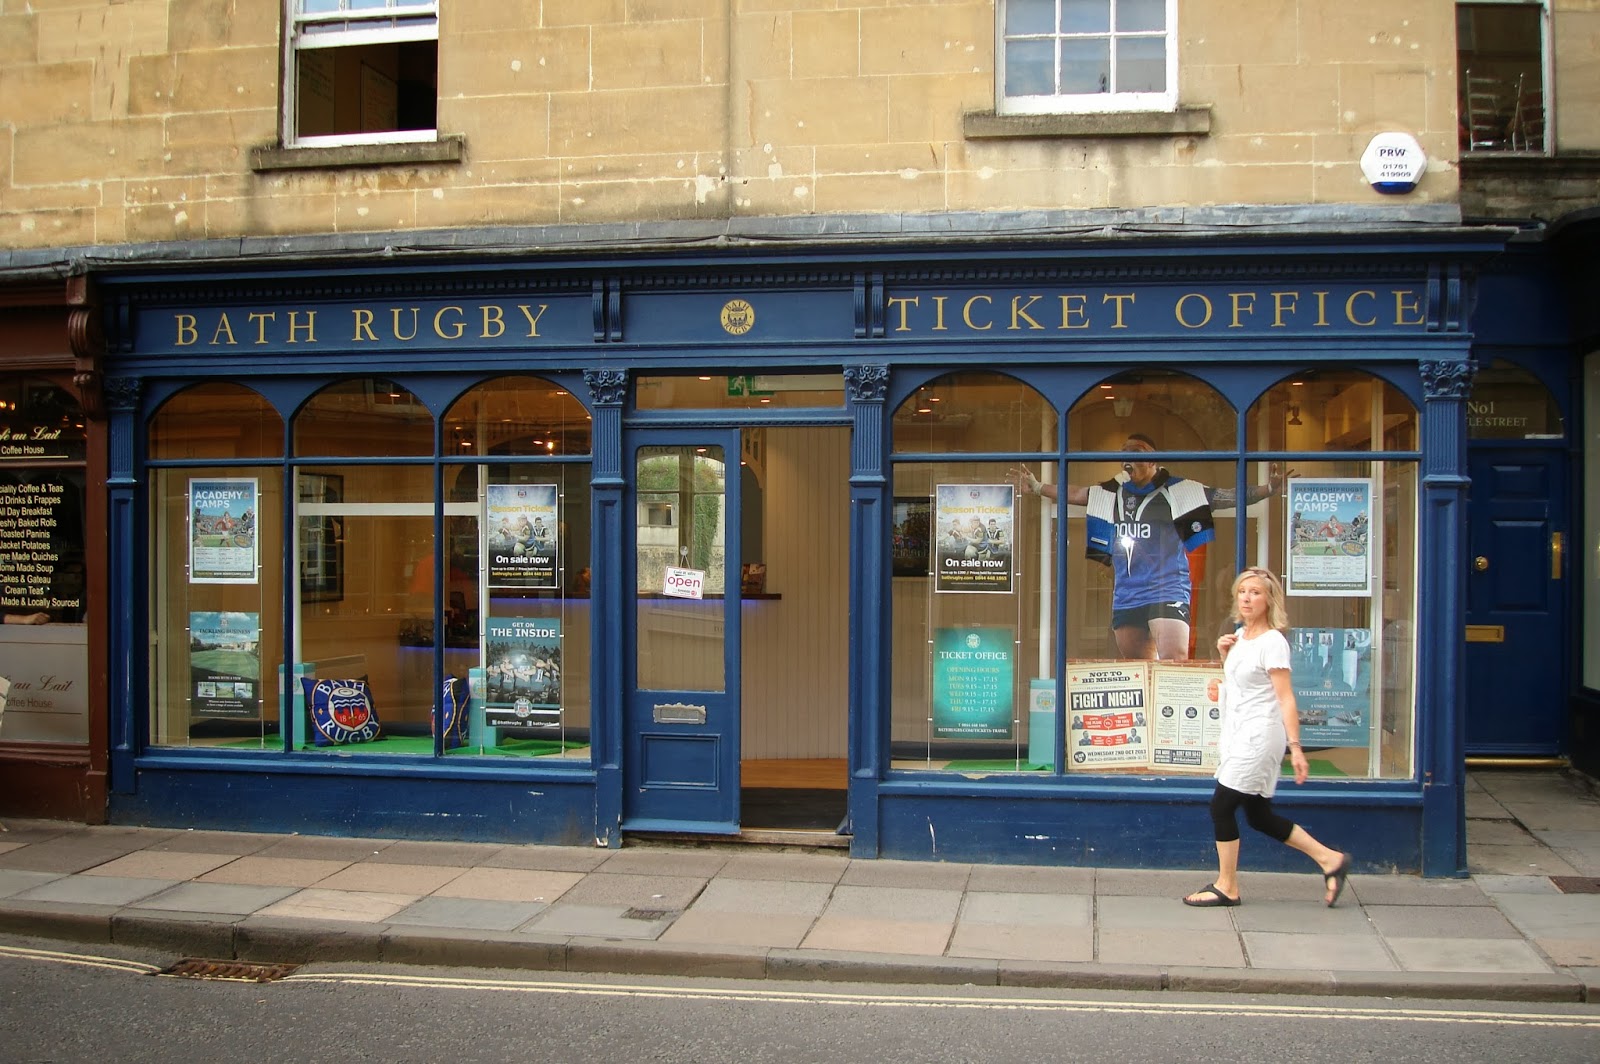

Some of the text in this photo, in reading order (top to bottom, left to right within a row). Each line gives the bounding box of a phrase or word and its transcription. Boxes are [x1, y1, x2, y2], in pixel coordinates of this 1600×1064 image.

[1380, 148, 1406, 157] PRW
[726, 302, 750, 311] BATH
[888, 290, 1425, 331] TICKET OFFICE
[174, 304, 548, 346] BATH RUGBY
[724, 322, 751, 334] RUGBY
[1485, 418, 1528, 426] STREET
[30, 426, 61, 440] Lait
[2, 446, 44, 454] Coffee House
[18, 484, 40, 493] Coffee
[41, 484, 46, 492] &
[48, 484, 64, 493] Teas
[195, 491, 243, 500] ACADEMY
[1294, 493, 1354, 502] ACADEMY
[5, 496, 26, 504] Drinks
[28, 496, 33, 504] &
[34, 496, 61, 506] Frappes
[195, 500, 230, 508] CAMPS
[490, 505, 522, 513] Season
[941, 506, 974, 514] Season
[1295, 502, 1338, 512] CAMPS
[7, 507, 20, 518] Day
[22, 507, 52, 516] Breakfast
[18, 518, 39, 528] Baked
[40, 518, 57, 528] Rolls
[0, 530, 50, 538] Toasted Paninis
[1114, 523, 1150, 538] novia
[0, 540, 50, 550] Jacket Potatoes
[12, 552, 30, 560] Made
[32, 552, 58, 561] Quiches
[496, 555, 549, 564] On sale now
[946, 558, 960, 566] On
[961, 558, 980, 567] sale
[16, 564, 35, 572] Made
[36, 564, 54, 574] Soup
[0, 574, 52, 584] Cakes & Gateau
[668, 576, 700, 588] open
[5, 586, 44, 595] Cream Teas
[2, 596, 80, 608] Made & Locally Sourced
[491, 628, 556, 638] THE INSIDE
[940, 651, 1007, 660] TICKET OFFICE
[14, 674, 73, 691] au Lait
[317, 680, 364, 696] BATH
[6, 697, 53, 708] offee House
[1072, 690, 1141, 708] FIGHT NIGHT
[321, 714, 379, 743] RUGBY
